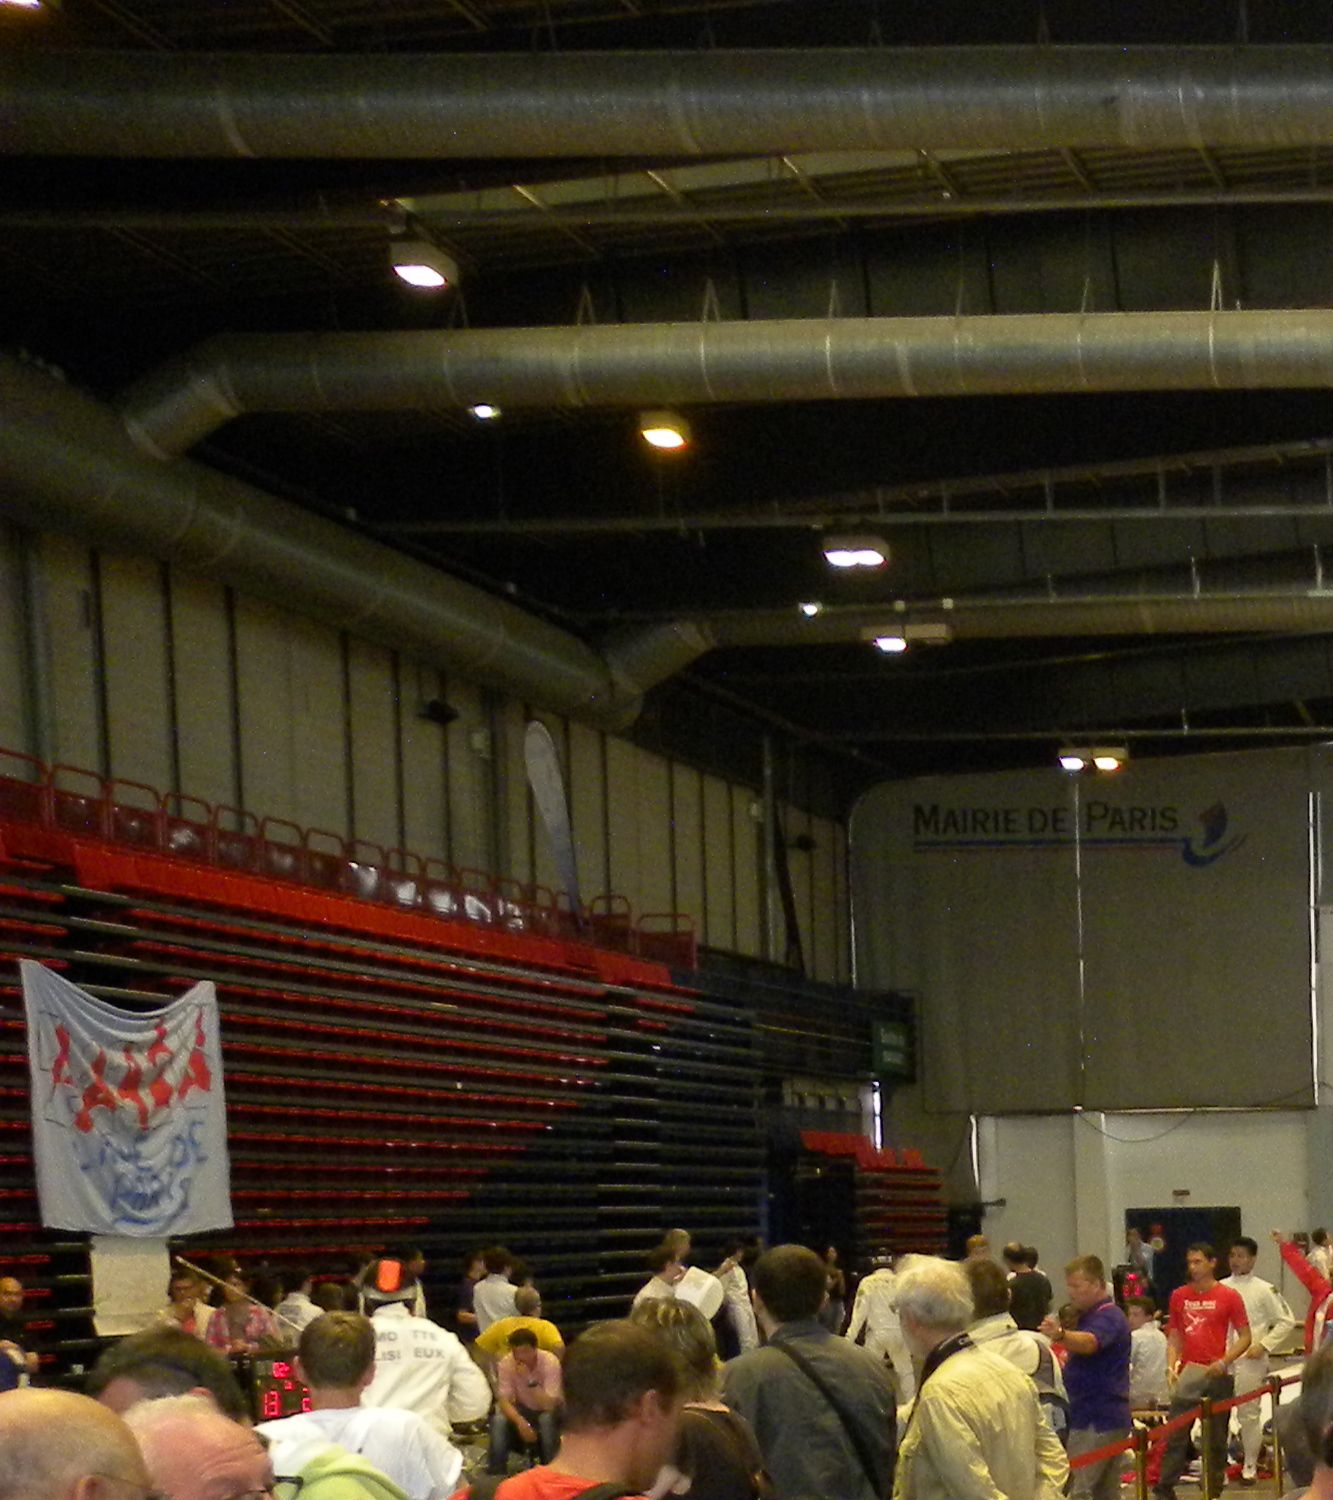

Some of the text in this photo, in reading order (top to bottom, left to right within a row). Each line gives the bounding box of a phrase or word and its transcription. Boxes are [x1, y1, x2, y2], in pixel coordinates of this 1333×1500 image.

[913, 801, 1179, 835] MAIRIE DE PARIS
